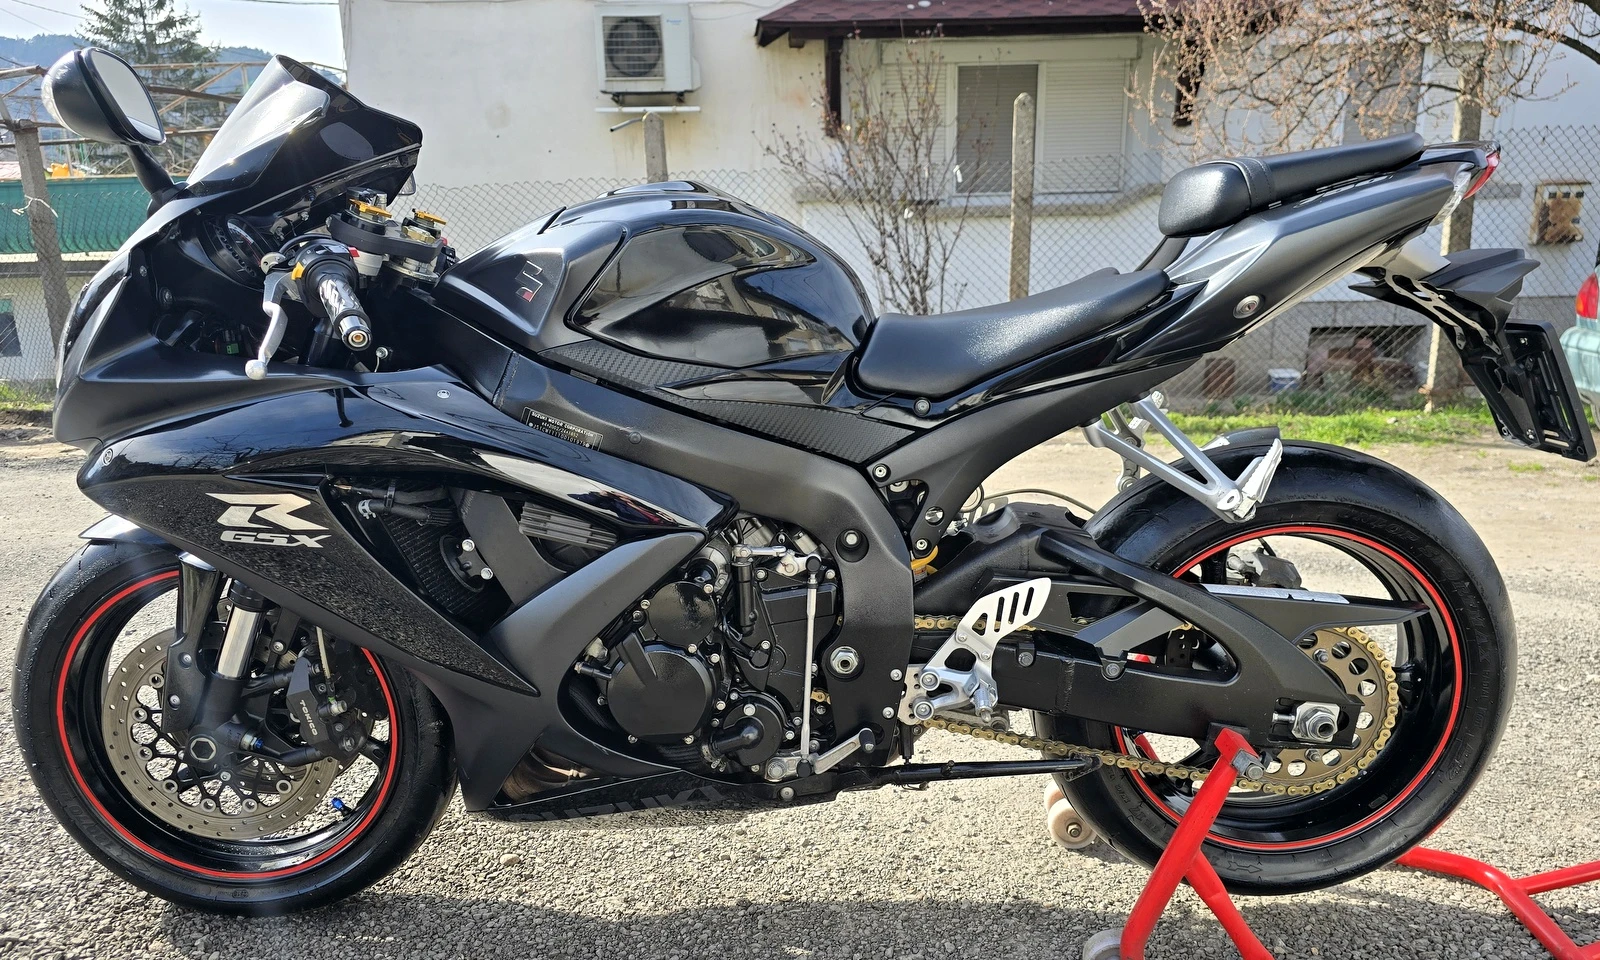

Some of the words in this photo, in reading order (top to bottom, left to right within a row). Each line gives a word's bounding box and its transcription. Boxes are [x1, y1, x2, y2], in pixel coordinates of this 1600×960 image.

[564, 423, 594, 437] CORPORATION
[205, 493, 330, 531] R
[219, 530, 332, 549] GSX
[299, 699, 318, 736] TOKICO
